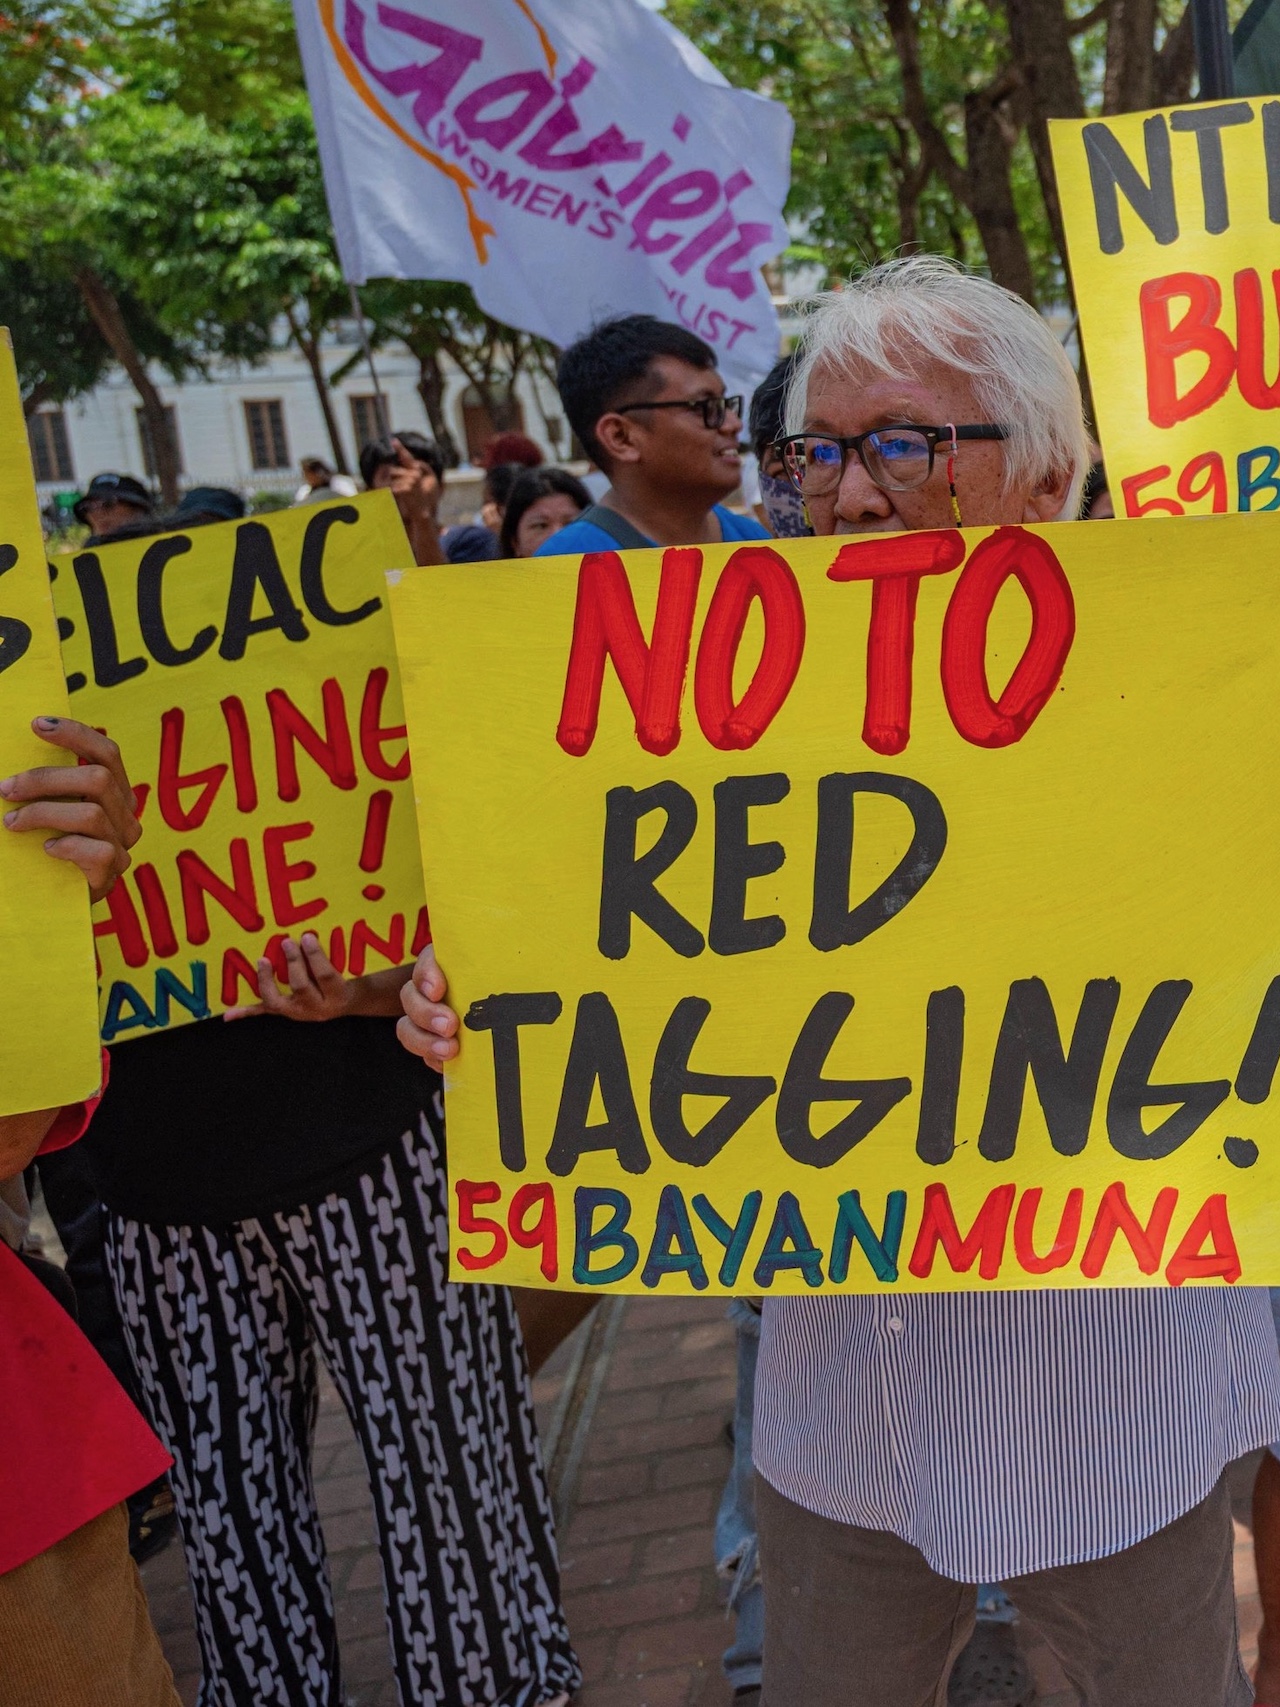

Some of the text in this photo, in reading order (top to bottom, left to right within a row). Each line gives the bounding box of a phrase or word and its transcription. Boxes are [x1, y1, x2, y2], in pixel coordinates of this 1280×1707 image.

[436, 120, 626, 241] WOMEN'S
[1121, 451, 1228, 518] 59
[556, 525, 1077, 757] NO TO
[597, 771, 948, 960] RED
[455, 1179, 1243, 1288] 59 BAYAN MUNA
